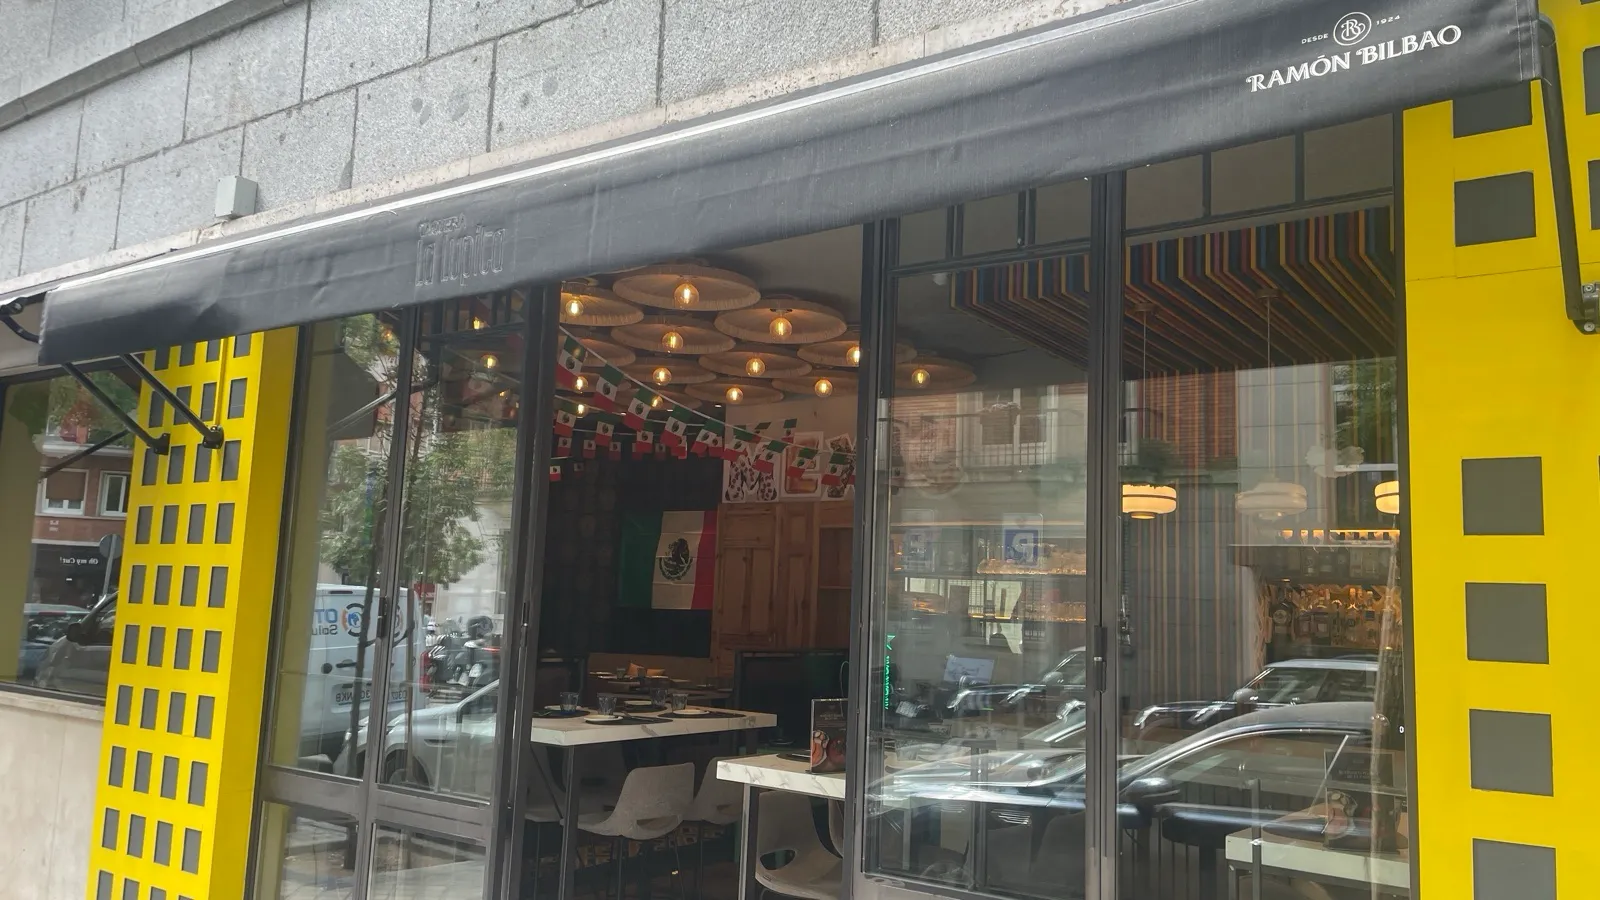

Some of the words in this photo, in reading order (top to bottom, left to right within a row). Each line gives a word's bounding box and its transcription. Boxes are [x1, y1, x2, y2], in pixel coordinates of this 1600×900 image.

[1301, 33, 1329, 44] DESDE
[1376, 15, 1401, 26] 1924
[1246, 52, 1351, 93] RAMÓN
[1356, 24, 1462, 66] BILBAO
